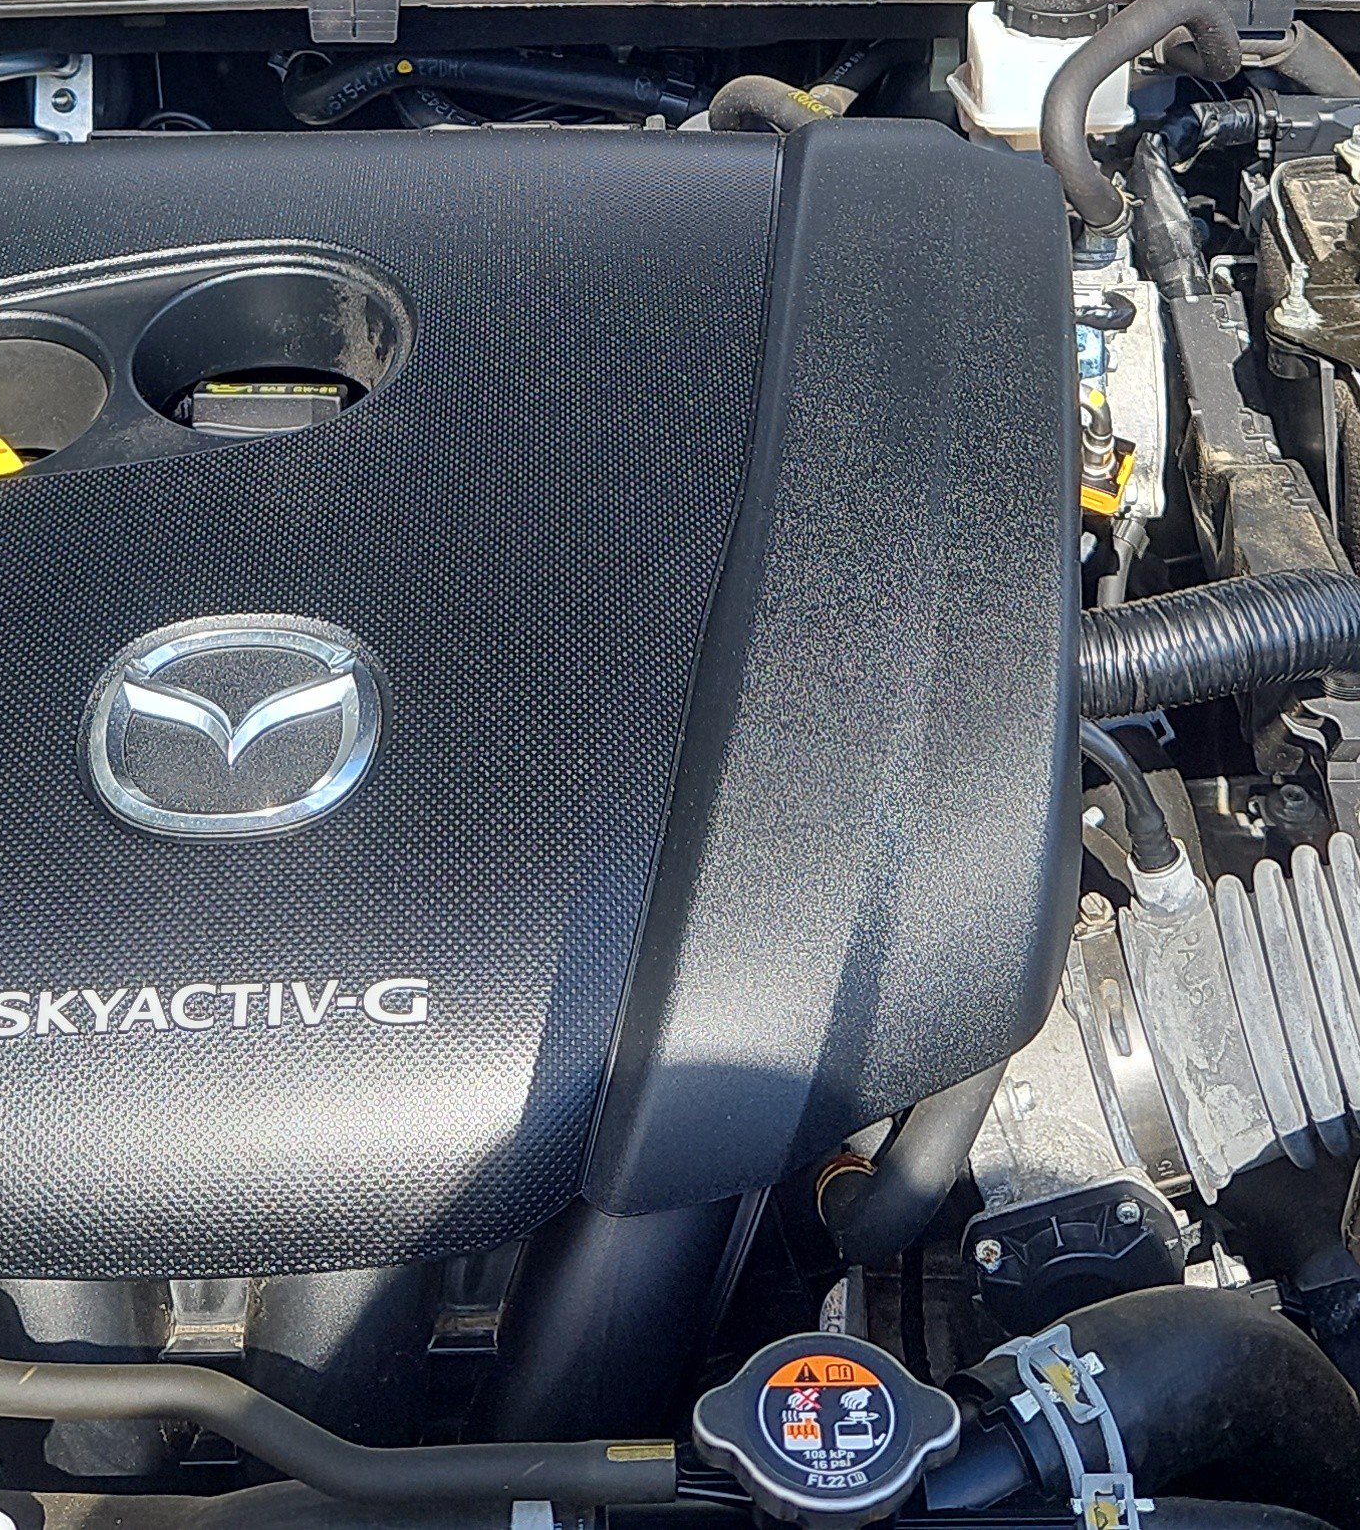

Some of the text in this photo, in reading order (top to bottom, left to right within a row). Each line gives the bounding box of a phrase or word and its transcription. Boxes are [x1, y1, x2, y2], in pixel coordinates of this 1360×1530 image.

[802, 1449, 855, 1459] 108 kPa
[811, 1459, 851, 1470] 16 psi
[806, 1472, 848, 1488] FL22
